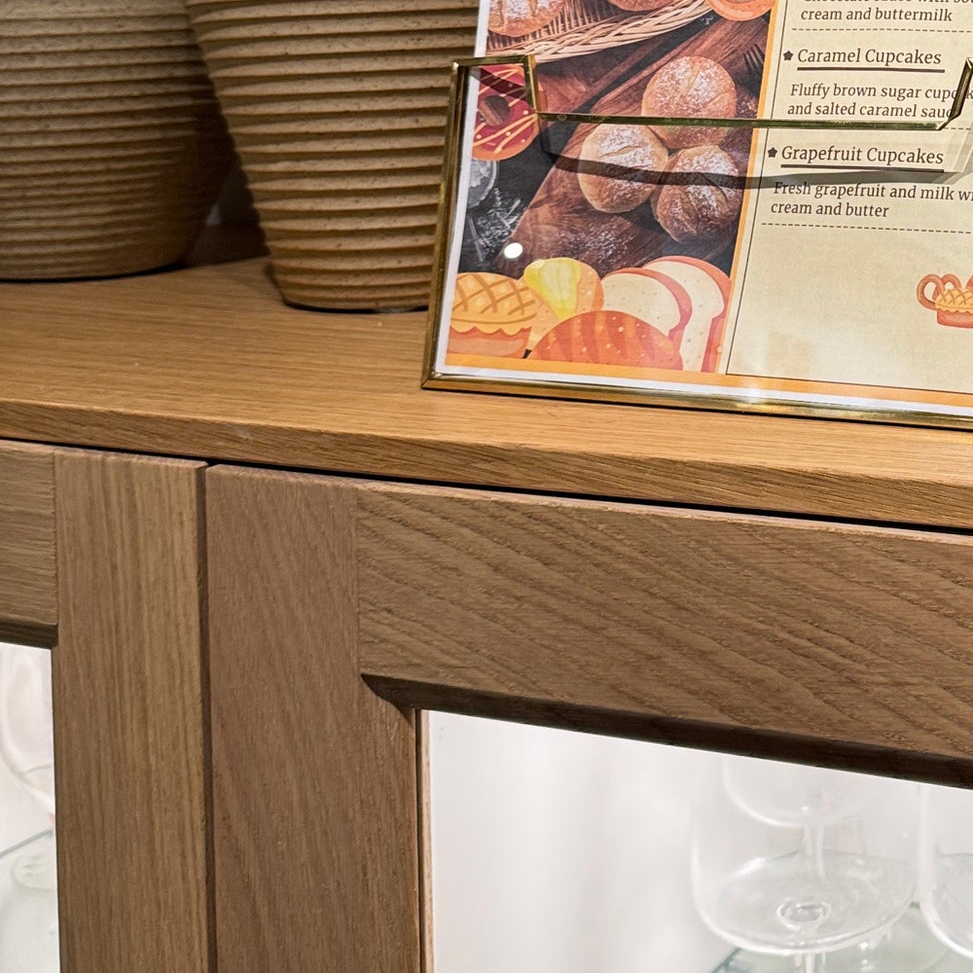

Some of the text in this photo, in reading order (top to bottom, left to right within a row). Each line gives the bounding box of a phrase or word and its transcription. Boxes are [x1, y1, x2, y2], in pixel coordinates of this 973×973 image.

[800, 7, 952, 21] cream and buttermilk
[798, 49, 942, 67] Caramel Cupcakes
[790, 84, 830, 99] Fluffy
[833, 84, 876, 97] brown
[880, 87, 922, 101] sugar
[787, 103, 952, 119] and salted caramel sauc
[781, 145, 944, 165] Grapefruit Cupcakes
[774, 181, 811, 195] Fresh
[814, 183, 886, 199] grapefruit
[890, 185, 916, 199] and
[920, 186, 954, 200] milk
[770, 201, 889, 217] cream and butter
